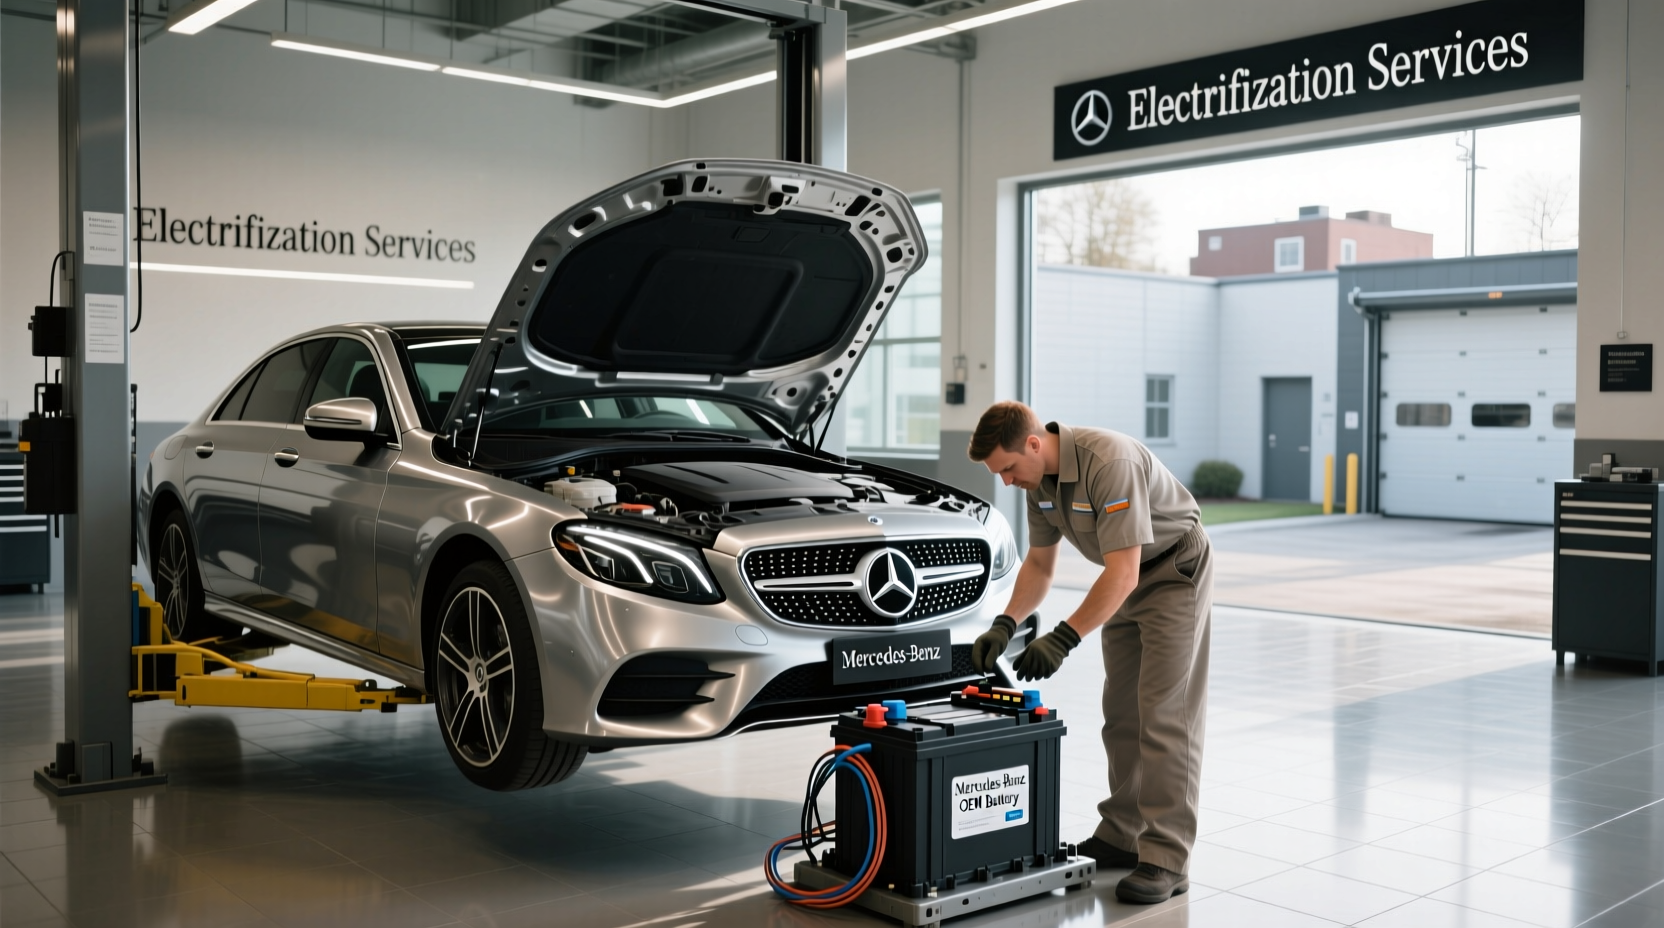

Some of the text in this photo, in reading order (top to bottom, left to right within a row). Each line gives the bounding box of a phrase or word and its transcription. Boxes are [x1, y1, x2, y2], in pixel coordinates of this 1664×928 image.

[1127, 30, 1529, 131] Electrifization Services
[133, 206, 476, 263] Electrifization Services
